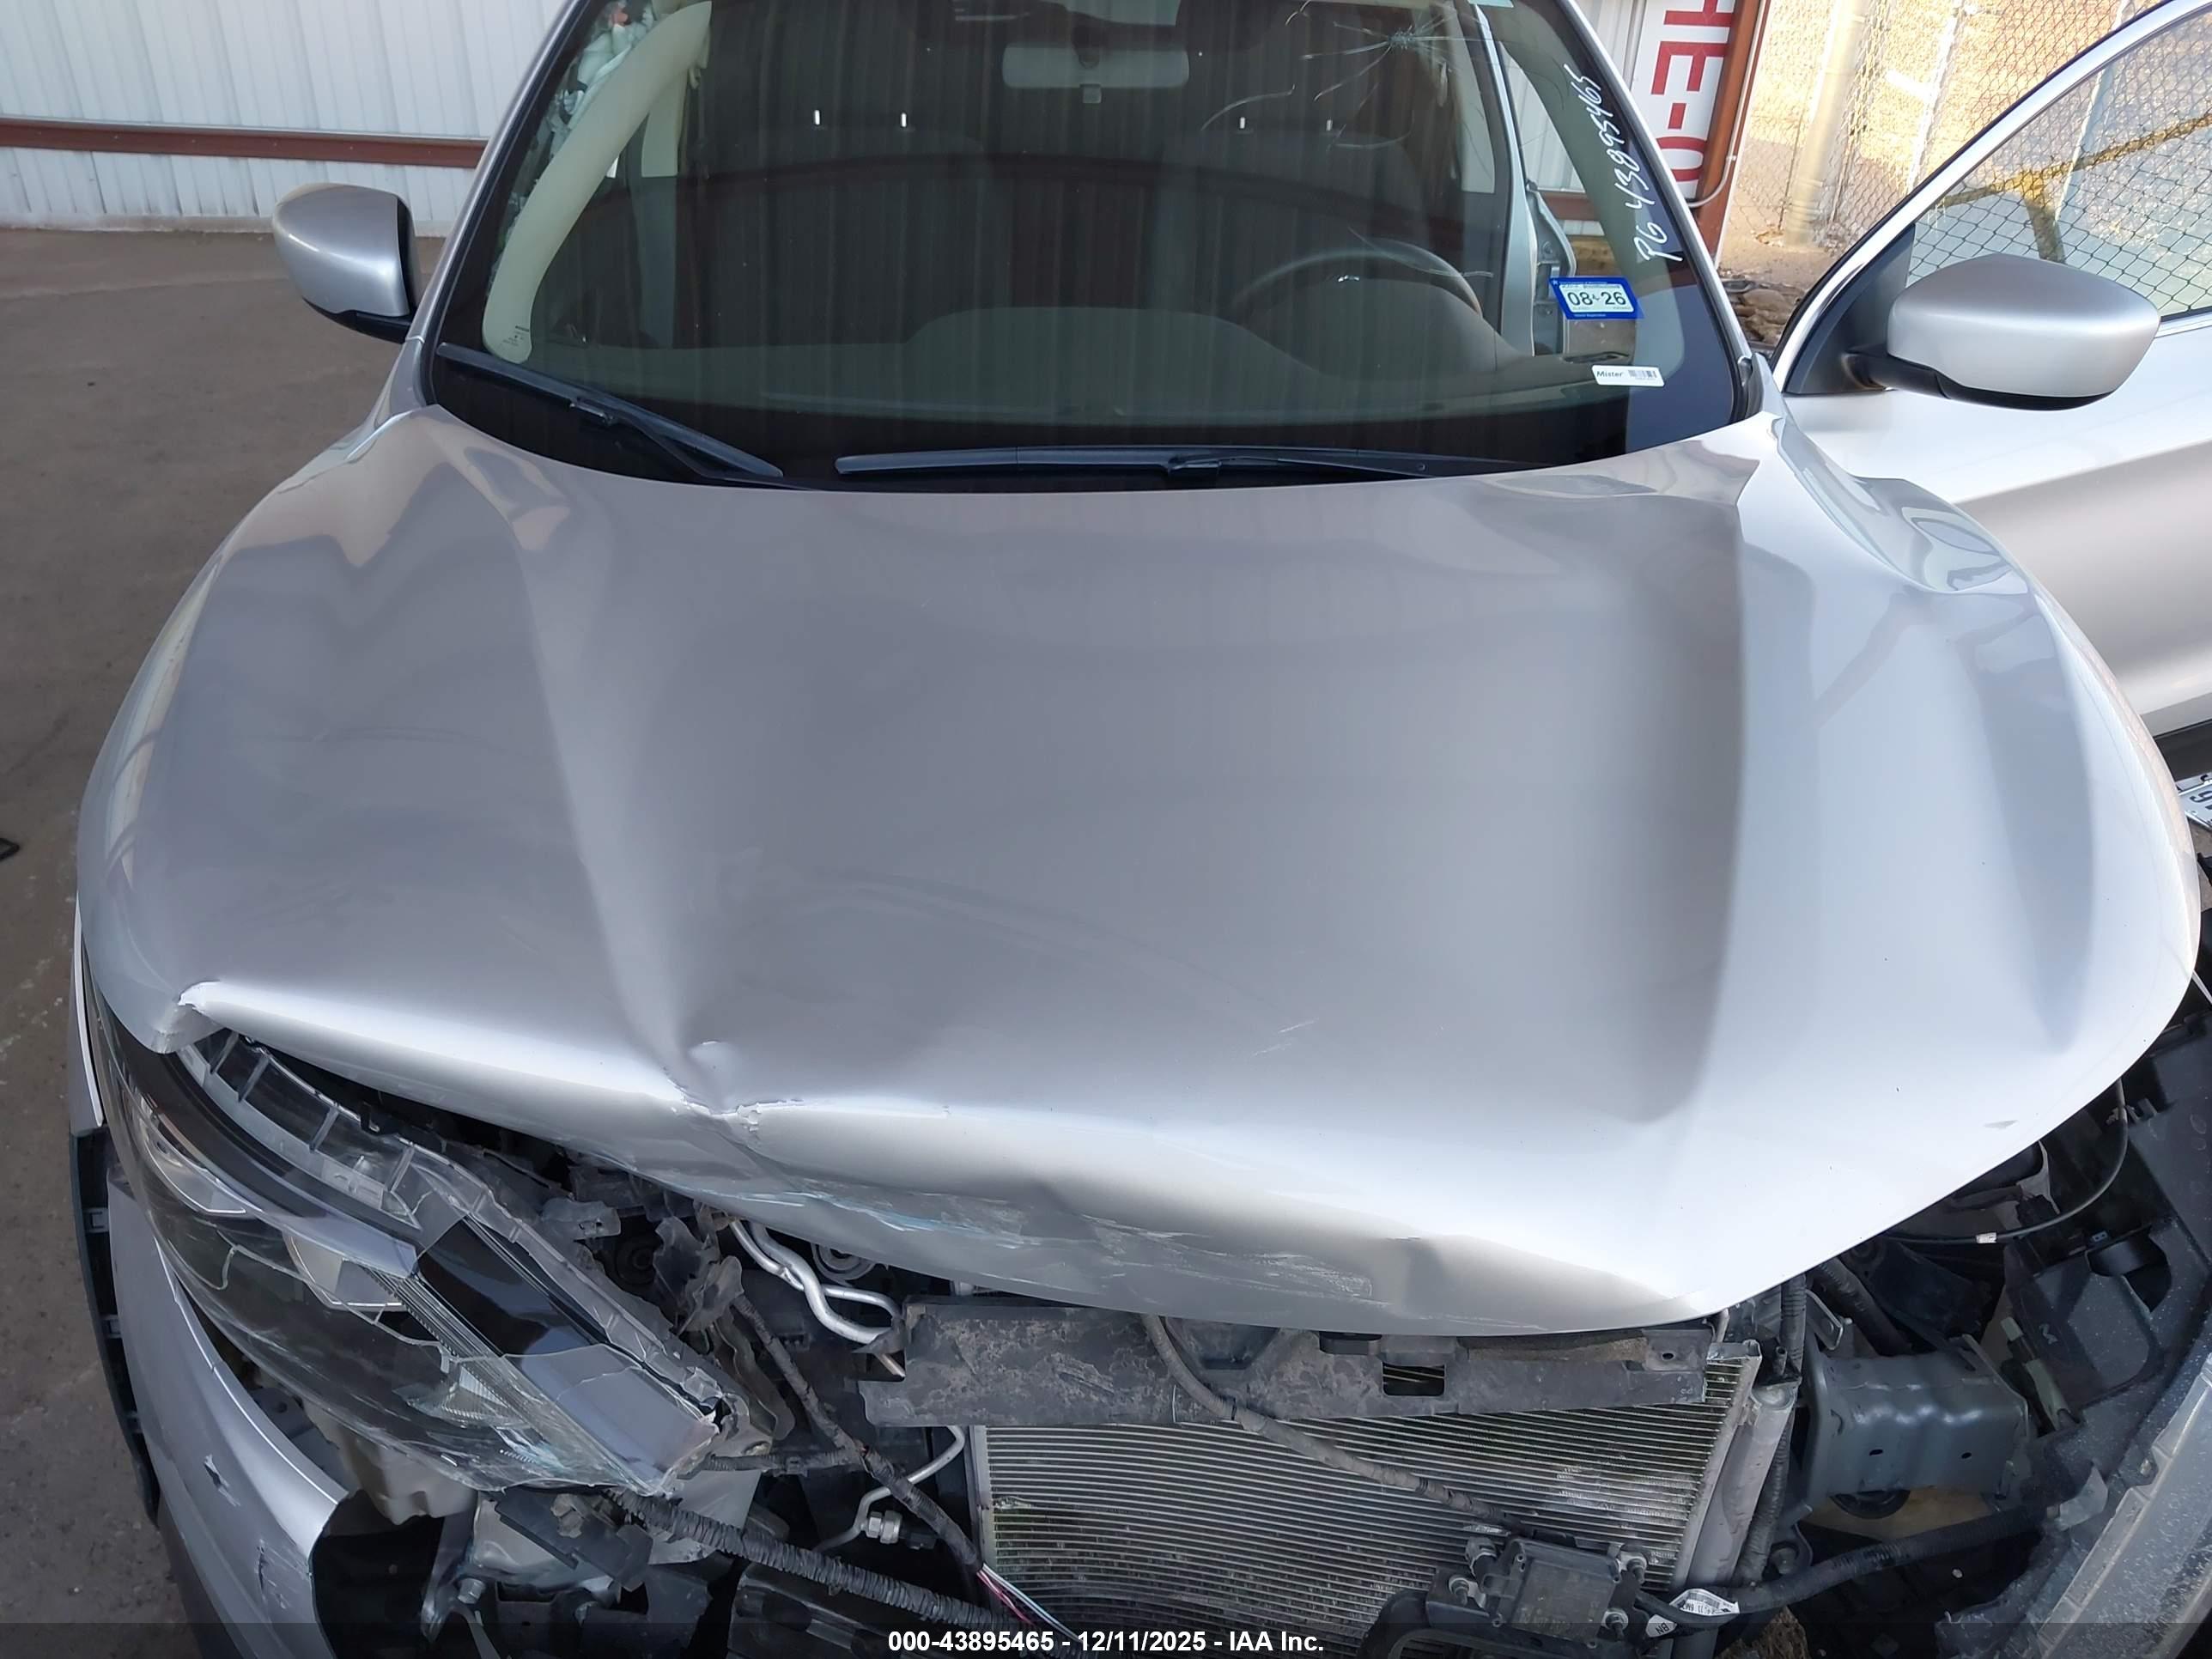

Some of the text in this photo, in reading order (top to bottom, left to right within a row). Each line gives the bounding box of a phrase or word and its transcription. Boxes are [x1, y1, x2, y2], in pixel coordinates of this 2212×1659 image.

[1564, 64, 1655, 210] 43895465
[1567, 291, 1626, 306] 08 26
